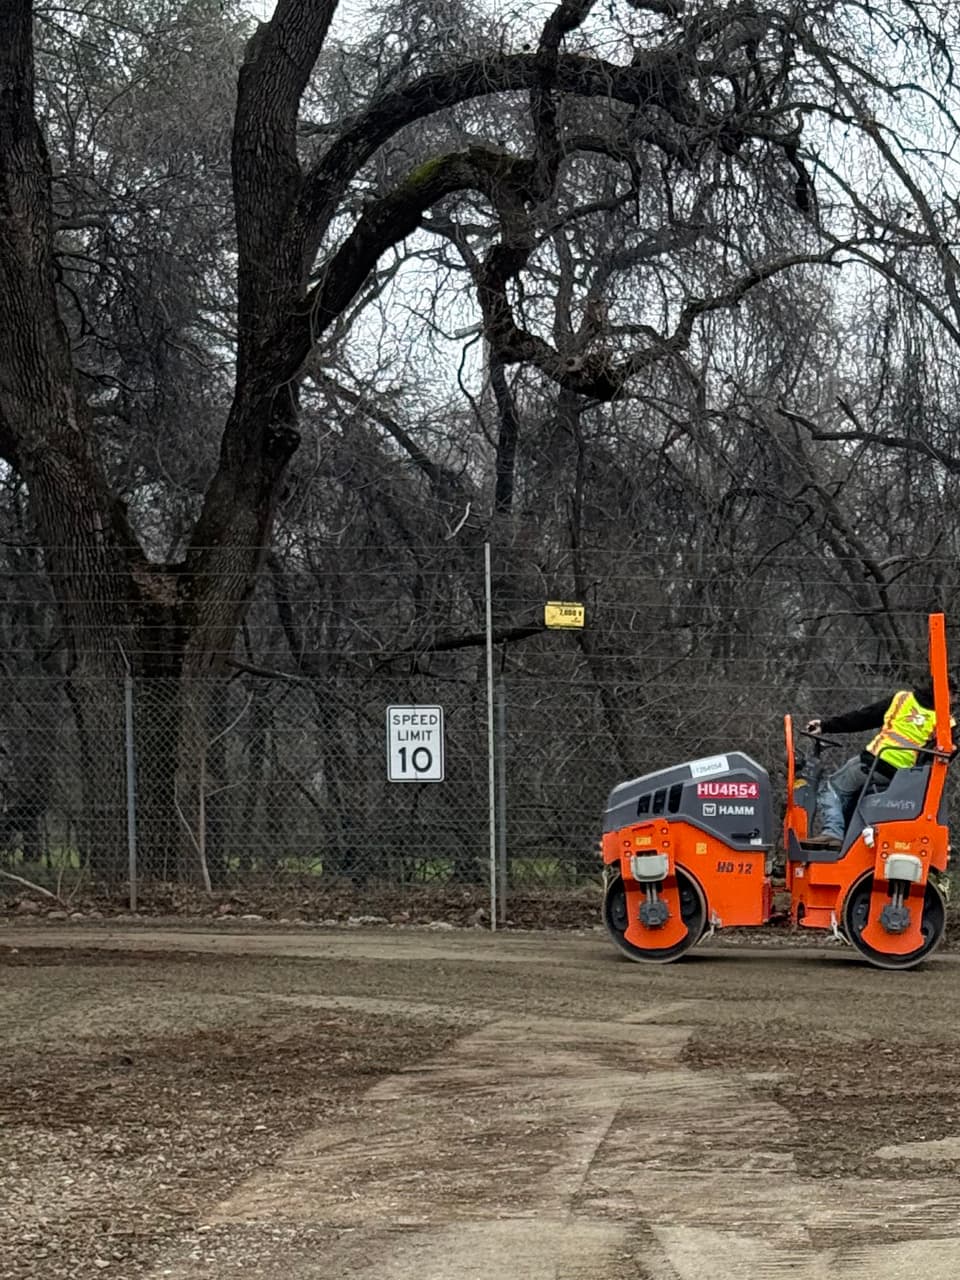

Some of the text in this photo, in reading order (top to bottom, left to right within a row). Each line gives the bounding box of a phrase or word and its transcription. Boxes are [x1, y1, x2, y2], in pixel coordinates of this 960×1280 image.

[393, 714, 437, 725] SPEED
[398, 730, 432, 741] LIMIT
[398, 747, 432, 773] 10
[697, 783, 758, 796] HU4R54
[719, 805, 754, 815] HAMM
[716, 861, 753, 875] HD 12
